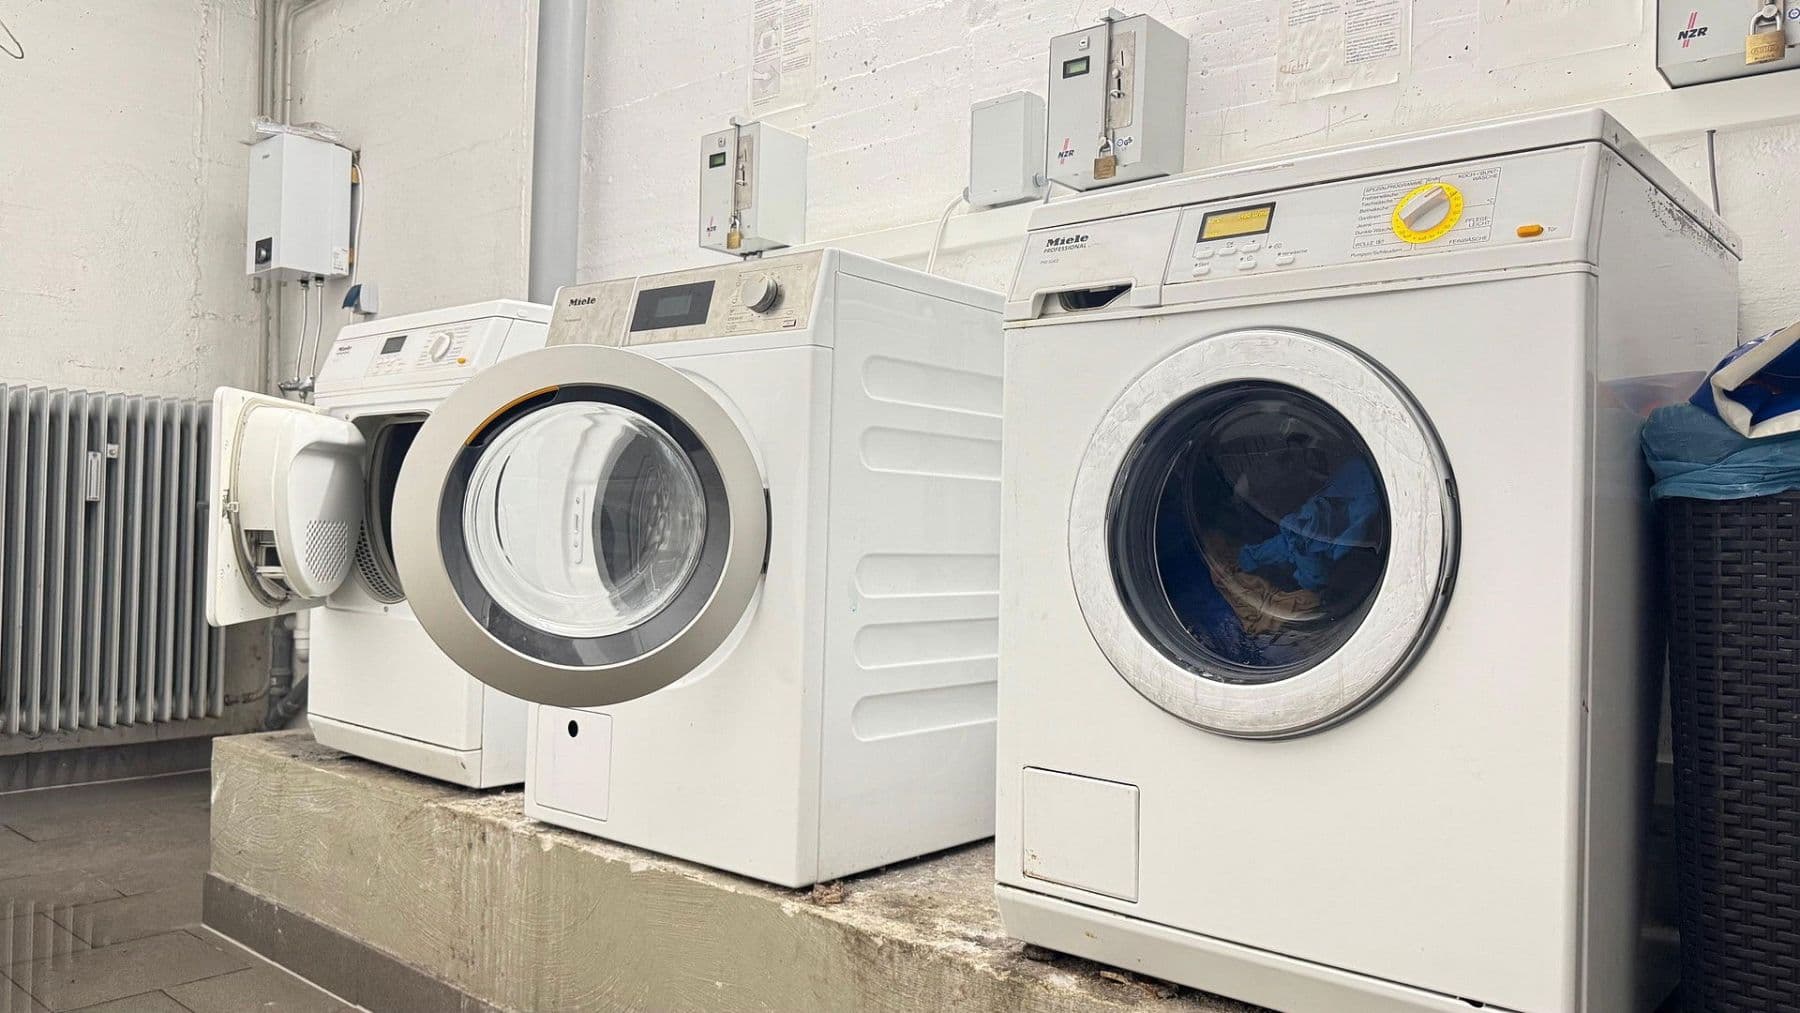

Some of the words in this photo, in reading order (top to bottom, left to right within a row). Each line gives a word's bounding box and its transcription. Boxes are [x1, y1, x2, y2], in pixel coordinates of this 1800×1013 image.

[1678, 27, 1708, 40] NZR
[1058, 149, 1075, 159] NZR
[1046, 234, 1089, 248] Miele
[1043, 243, 1087, 253] PROFESSIONAL
[568, 296, 597, 307] Miele
